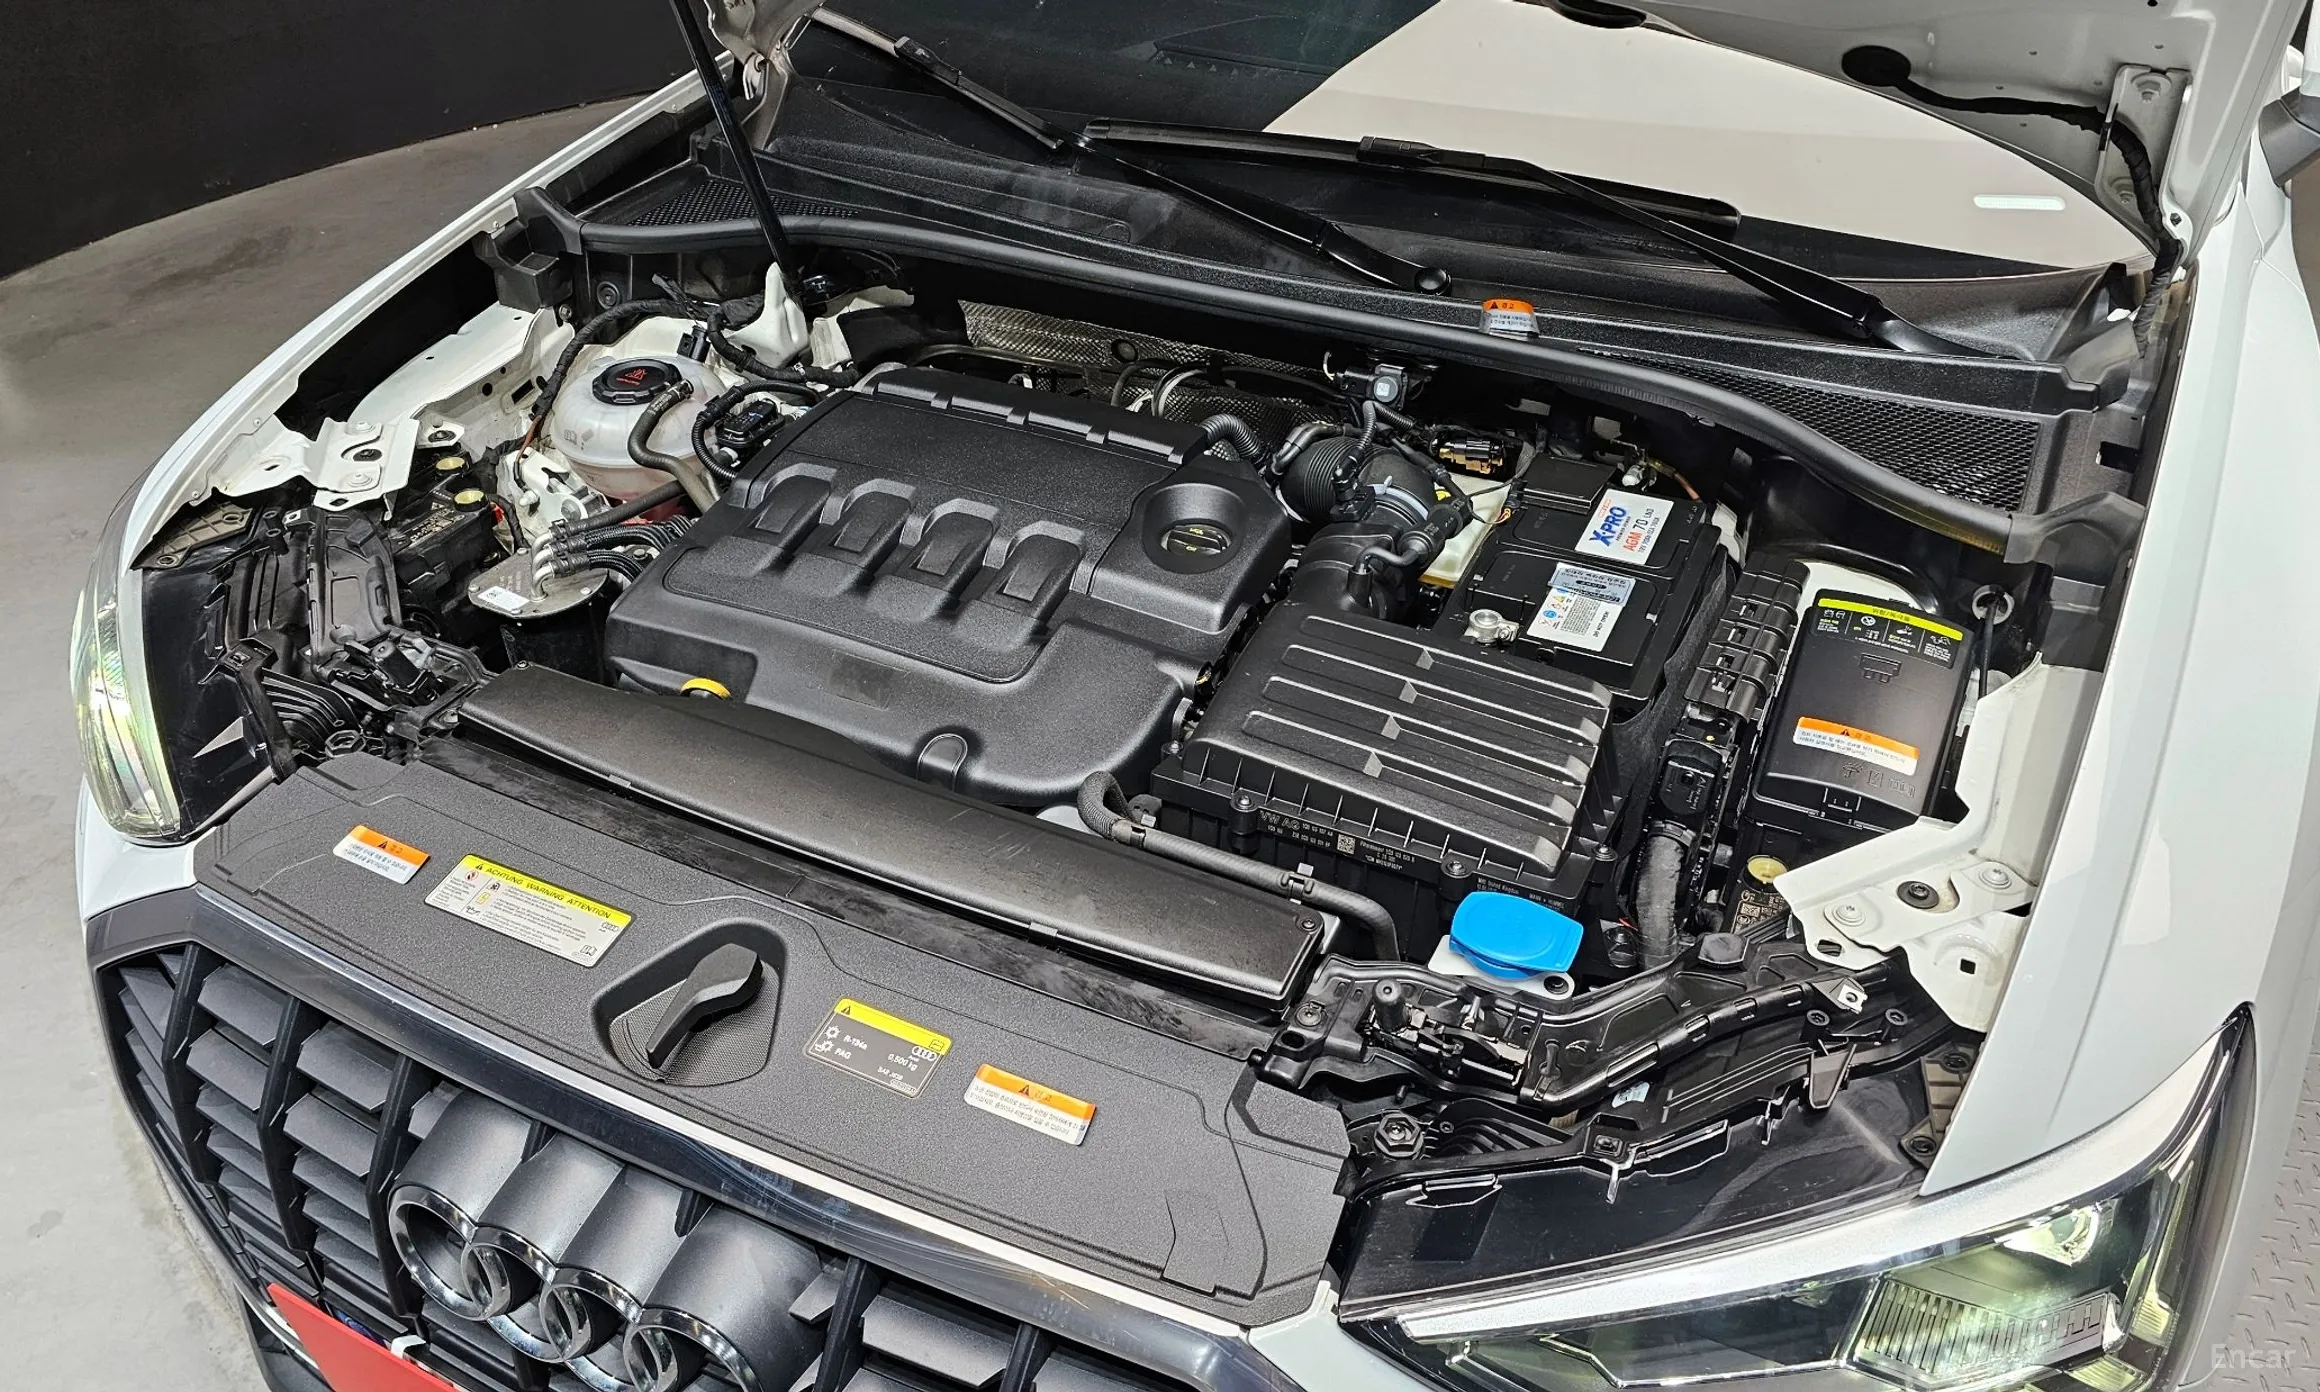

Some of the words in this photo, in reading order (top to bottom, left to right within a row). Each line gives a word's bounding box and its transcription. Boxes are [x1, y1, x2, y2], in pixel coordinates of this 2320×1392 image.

[1623, 531, 1643, 551] AGM
[1633, 518, 1648, 531] 70
[486, 867, 523, 885] ACHTUNG
[526, 882, 564, 901] WARNING
[567, 897, 612, 919] ATTENTION
[834, 1048, 852, 1060] PAG
